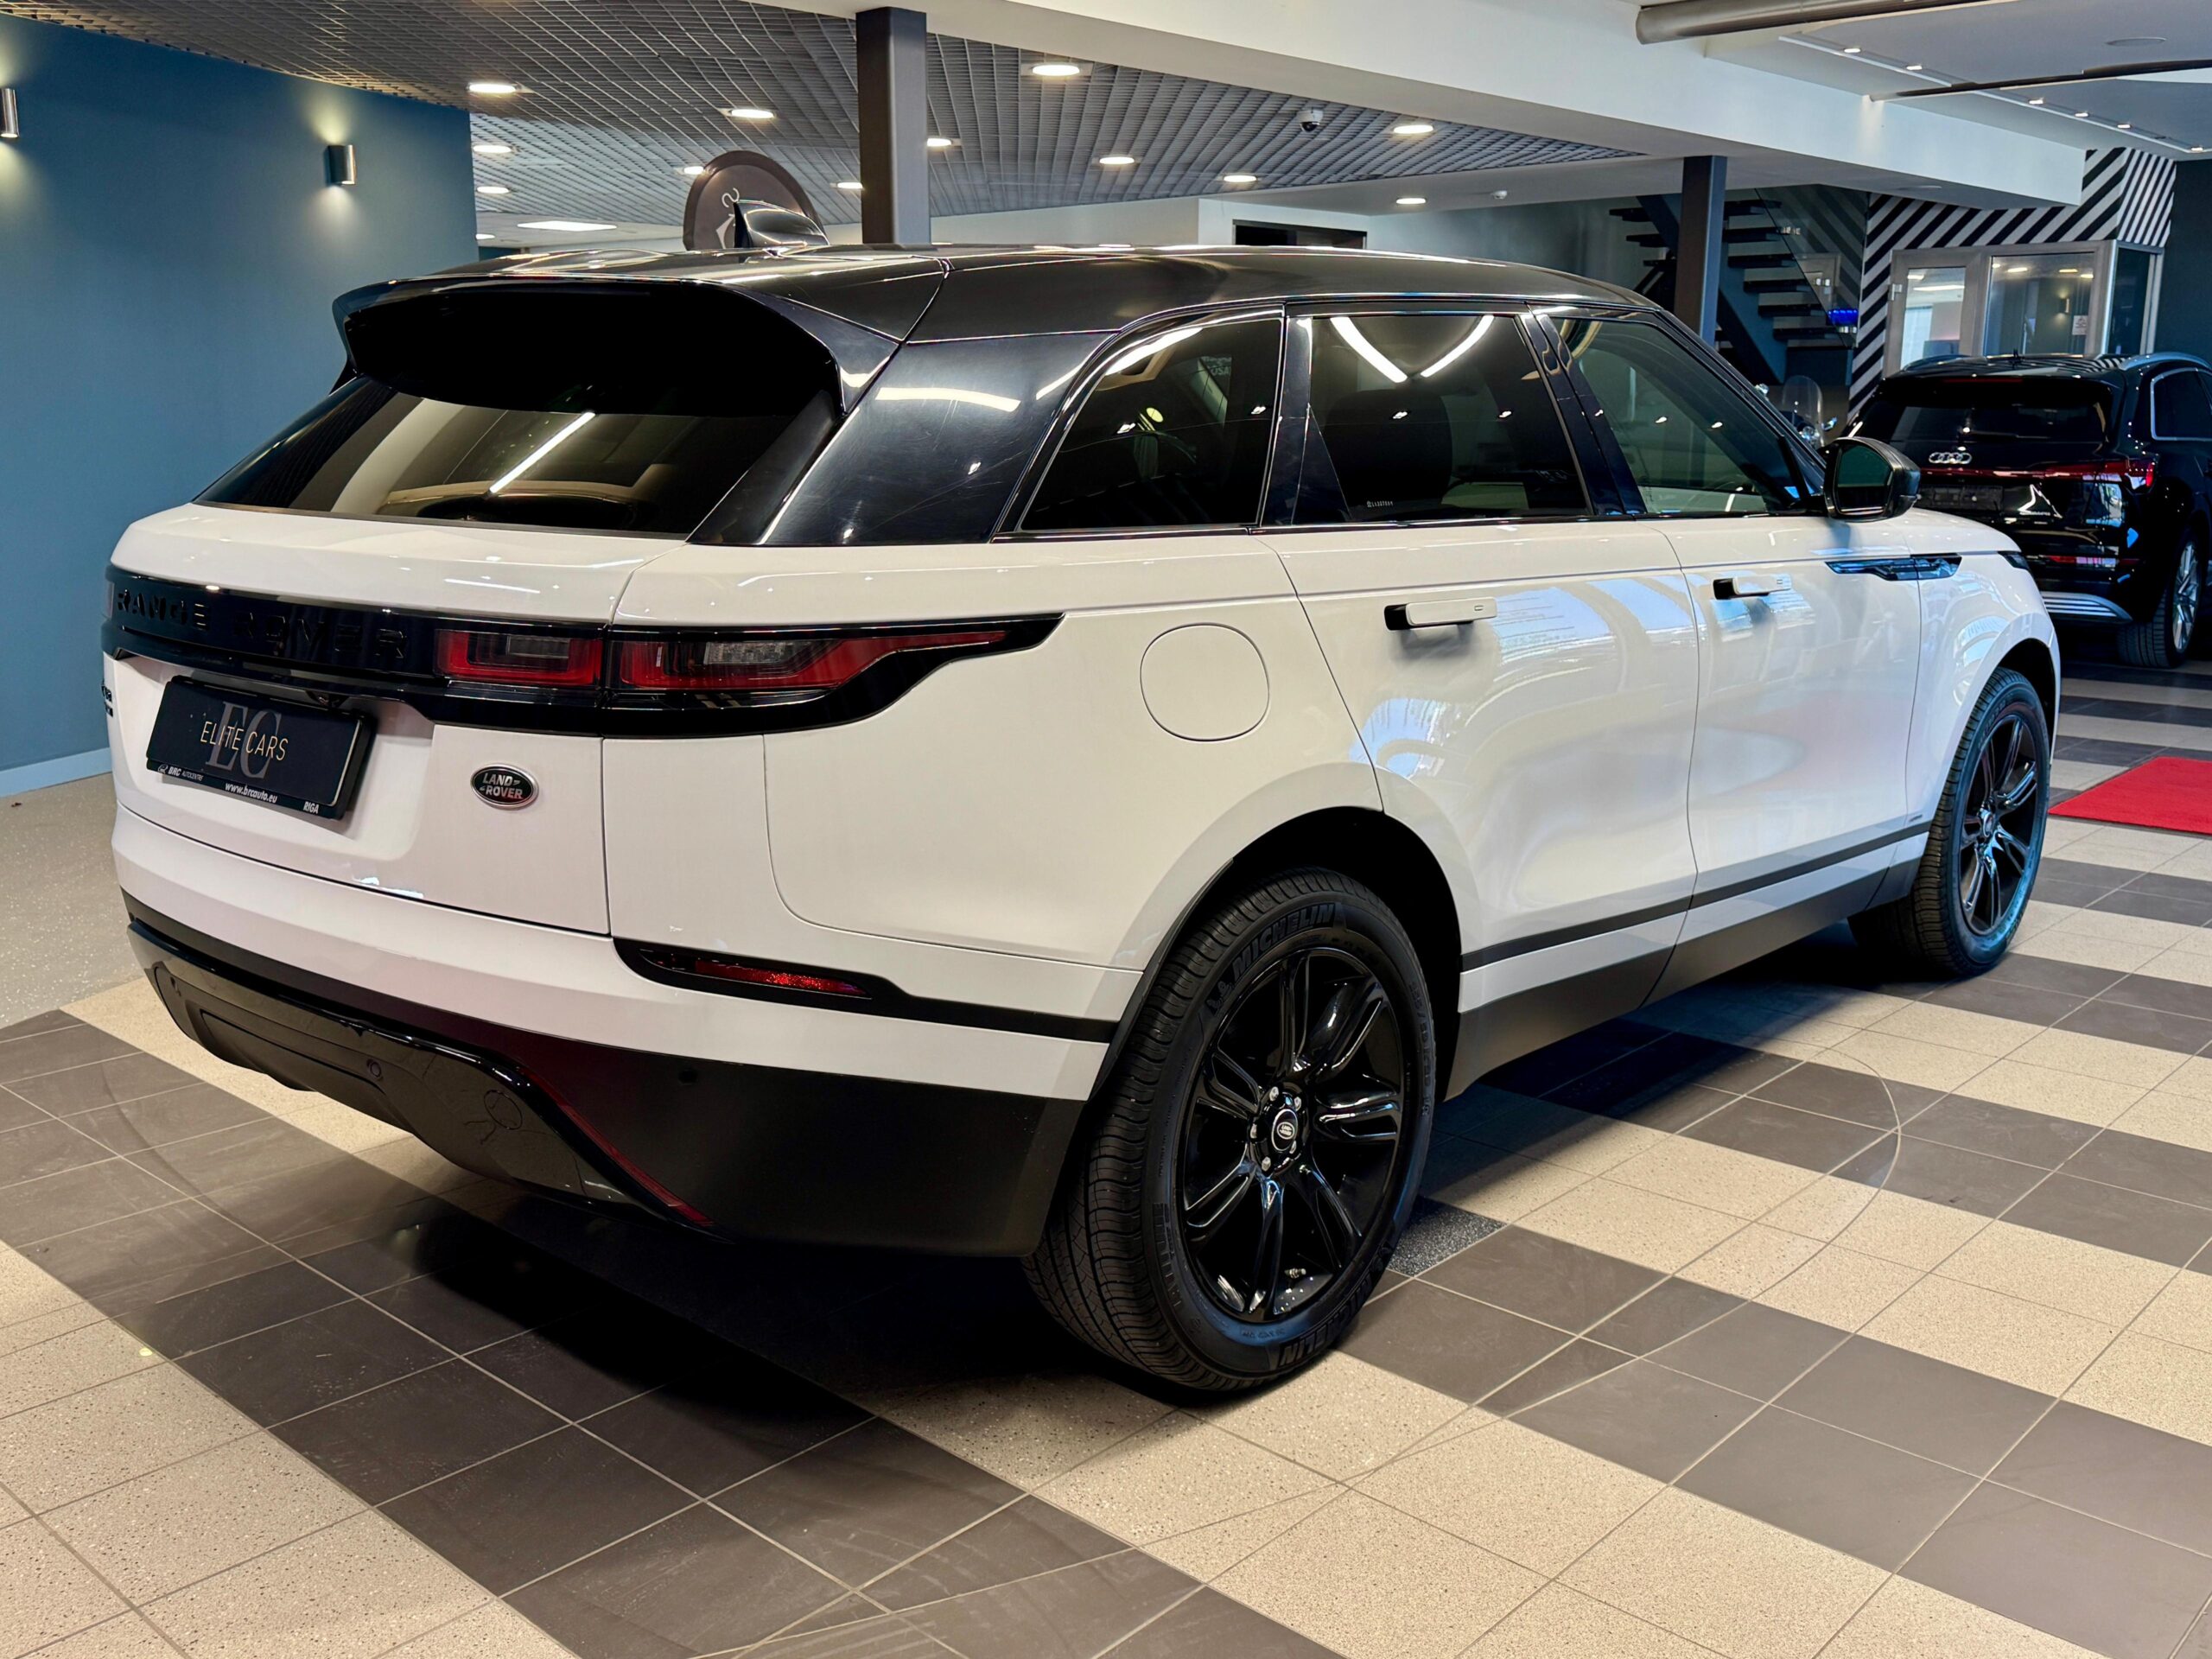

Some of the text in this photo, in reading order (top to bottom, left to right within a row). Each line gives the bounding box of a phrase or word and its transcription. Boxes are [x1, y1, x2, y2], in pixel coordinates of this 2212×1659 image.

[118, 588, 409, 659] RANGE ROVER
[200, 721, 289, 761] ELITE CARS
[168, 766, 182, 777] BRC
[224, 782, 278, 804] www.brcauto.eu
[482, 772, 524, 799] LAND ROVER
[302, 801, 320, 815] RIGA
[1233, 902, 1337, 980] MICHELIN
